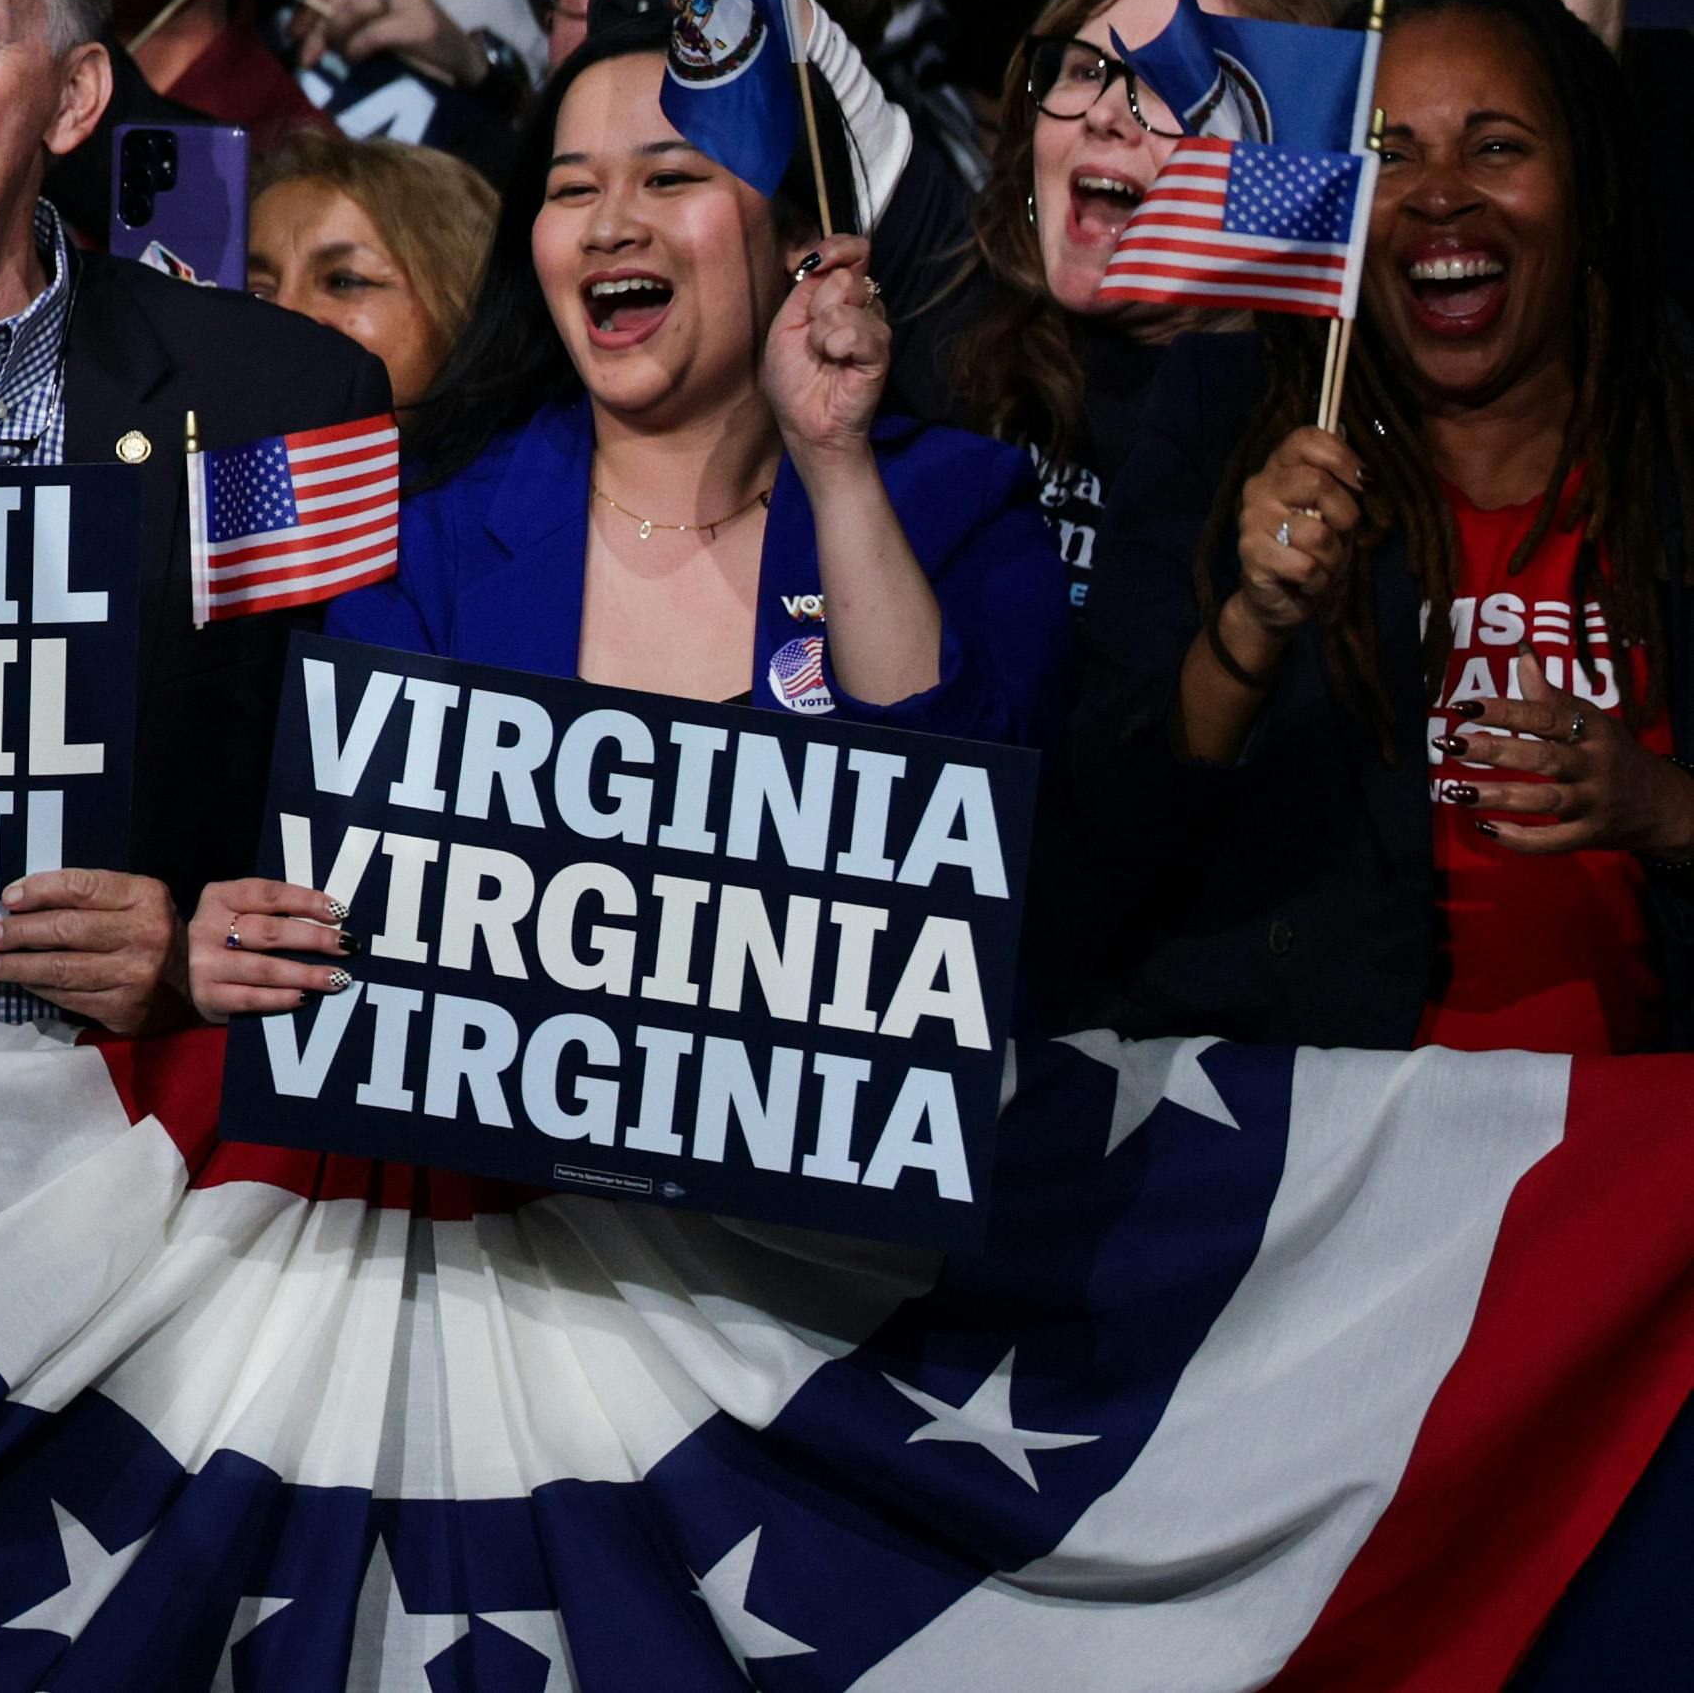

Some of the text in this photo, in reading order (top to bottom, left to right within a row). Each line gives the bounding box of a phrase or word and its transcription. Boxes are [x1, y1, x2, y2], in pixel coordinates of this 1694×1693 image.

[302, 657, 1010, 899] VIRGINIA
[279, 812, 992, 1051] VIRGINIA
[261, 980, 975, 1204] VIRGINIA
